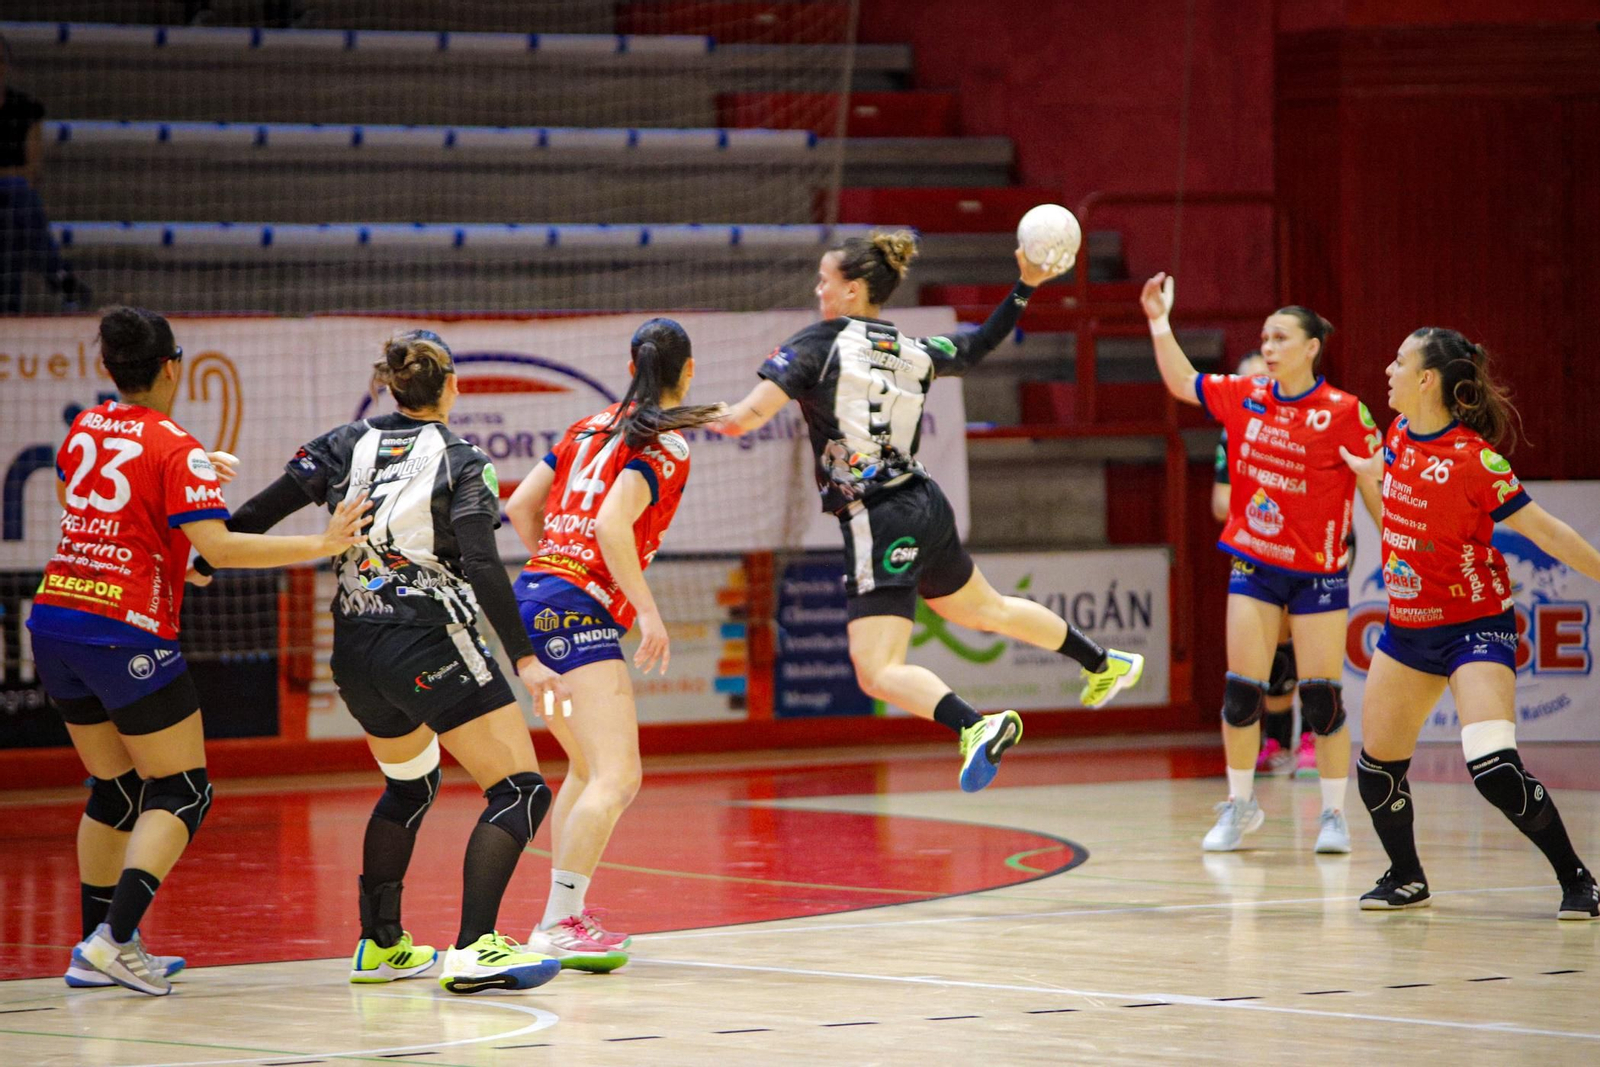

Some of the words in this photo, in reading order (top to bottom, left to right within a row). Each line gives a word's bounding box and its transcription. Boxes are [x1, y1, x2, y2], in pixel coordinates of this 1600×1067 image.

[79, 412, 145, 437] ABANCA
[1305, 408, 1332, 432] 10
[65, 431, 144, 513] 23
[560, 425, 624, 511] 14
[1419, 455, 1455, 485] 26
[1391, 478, 1412, 495] XUNTA
[1396, 492, 1429, 509] GALICIA
[890, 547, 919, 563] CSIF
[47, 574, 124, 600] ELECPOR
[1384, 571, 1420, 589] ORBE
